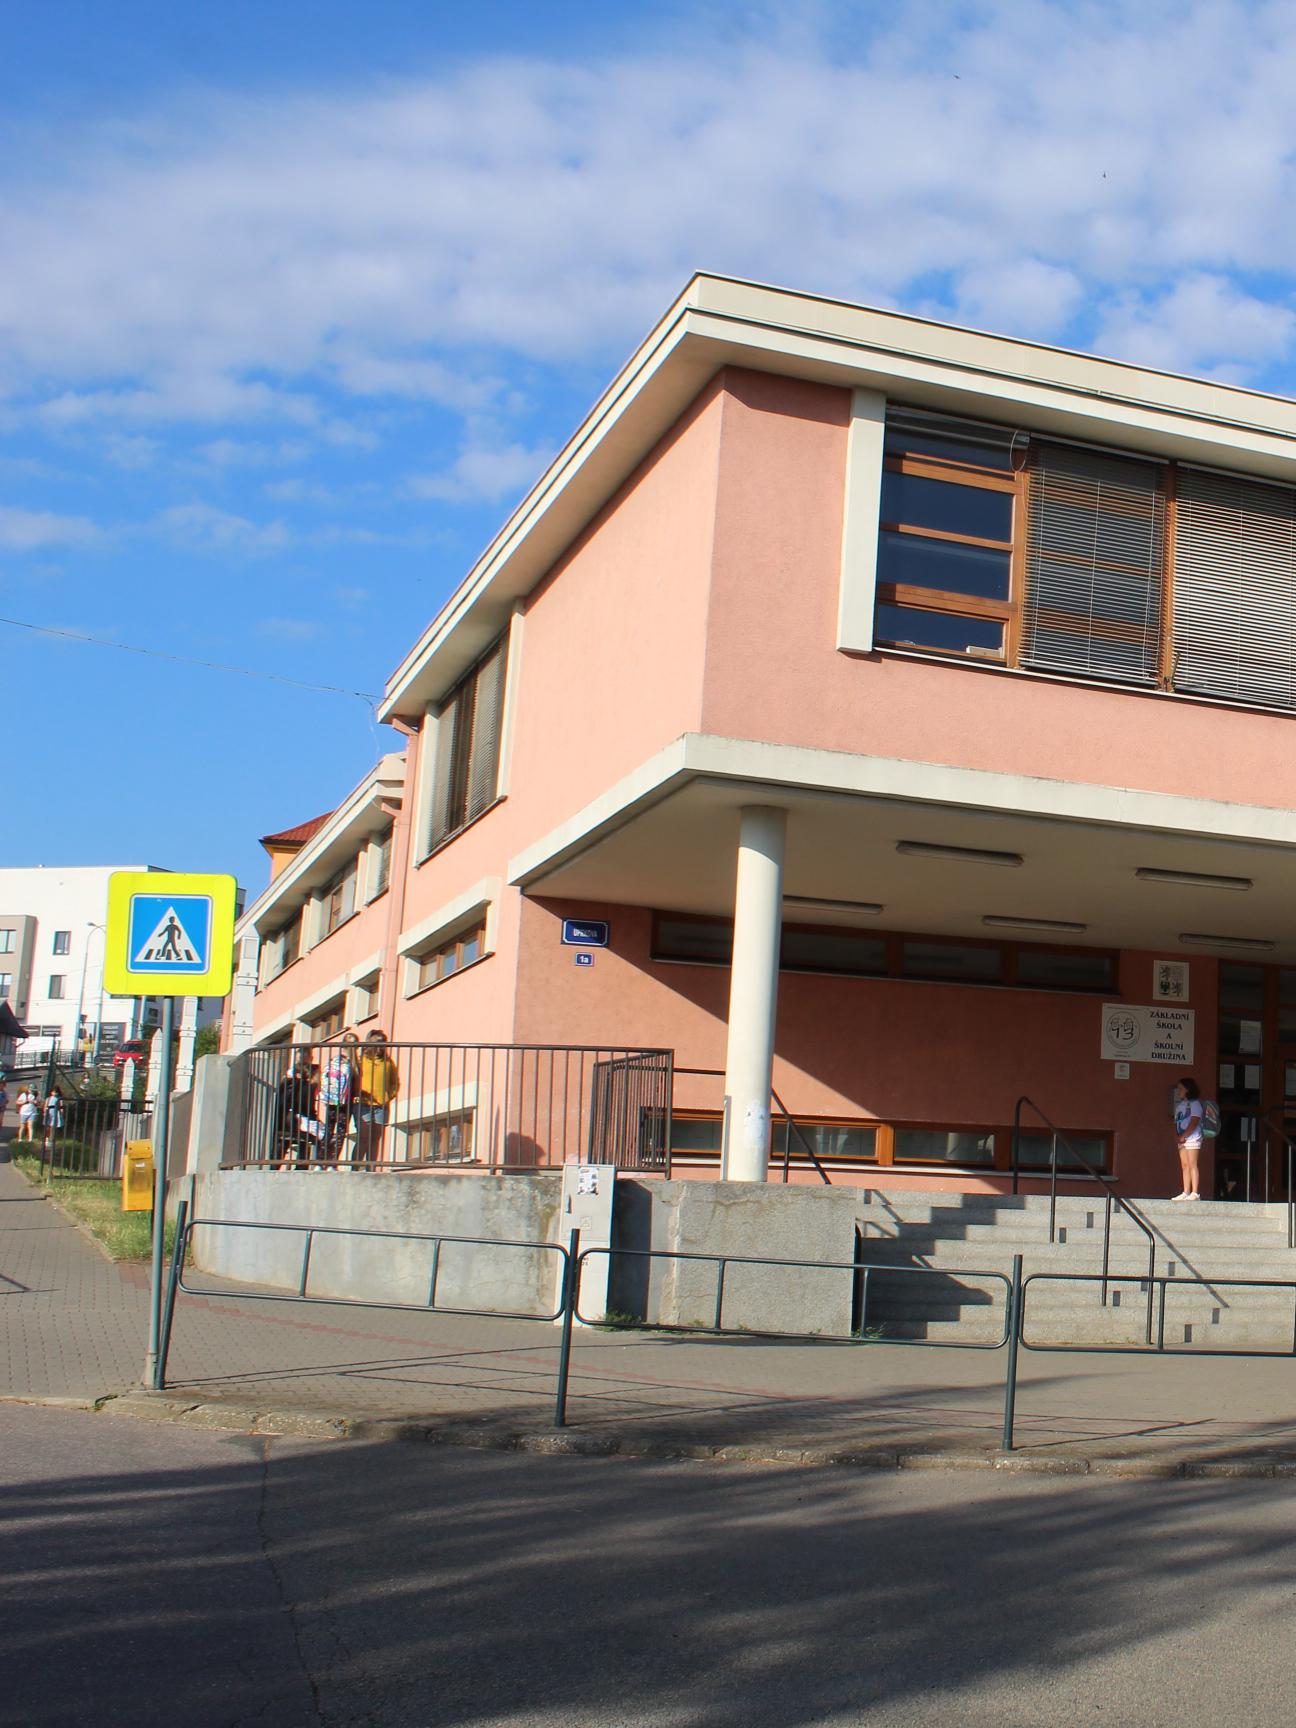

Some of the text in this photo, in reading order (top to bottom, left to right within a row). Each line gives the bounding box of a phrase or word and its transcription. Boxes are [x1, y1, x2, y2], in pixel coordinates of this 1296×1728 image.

[579, 955, 589, 964] 1a
[1150, 1010, 1189, 1020] ZÁKLADNÍ
[1156, 1020, 1183, 1030] ŠKOLA
[1154, 1040, 1184, 1050] ŠKOLNÍ
[1151, 1050, 1186, 1060] DRUŽINA
